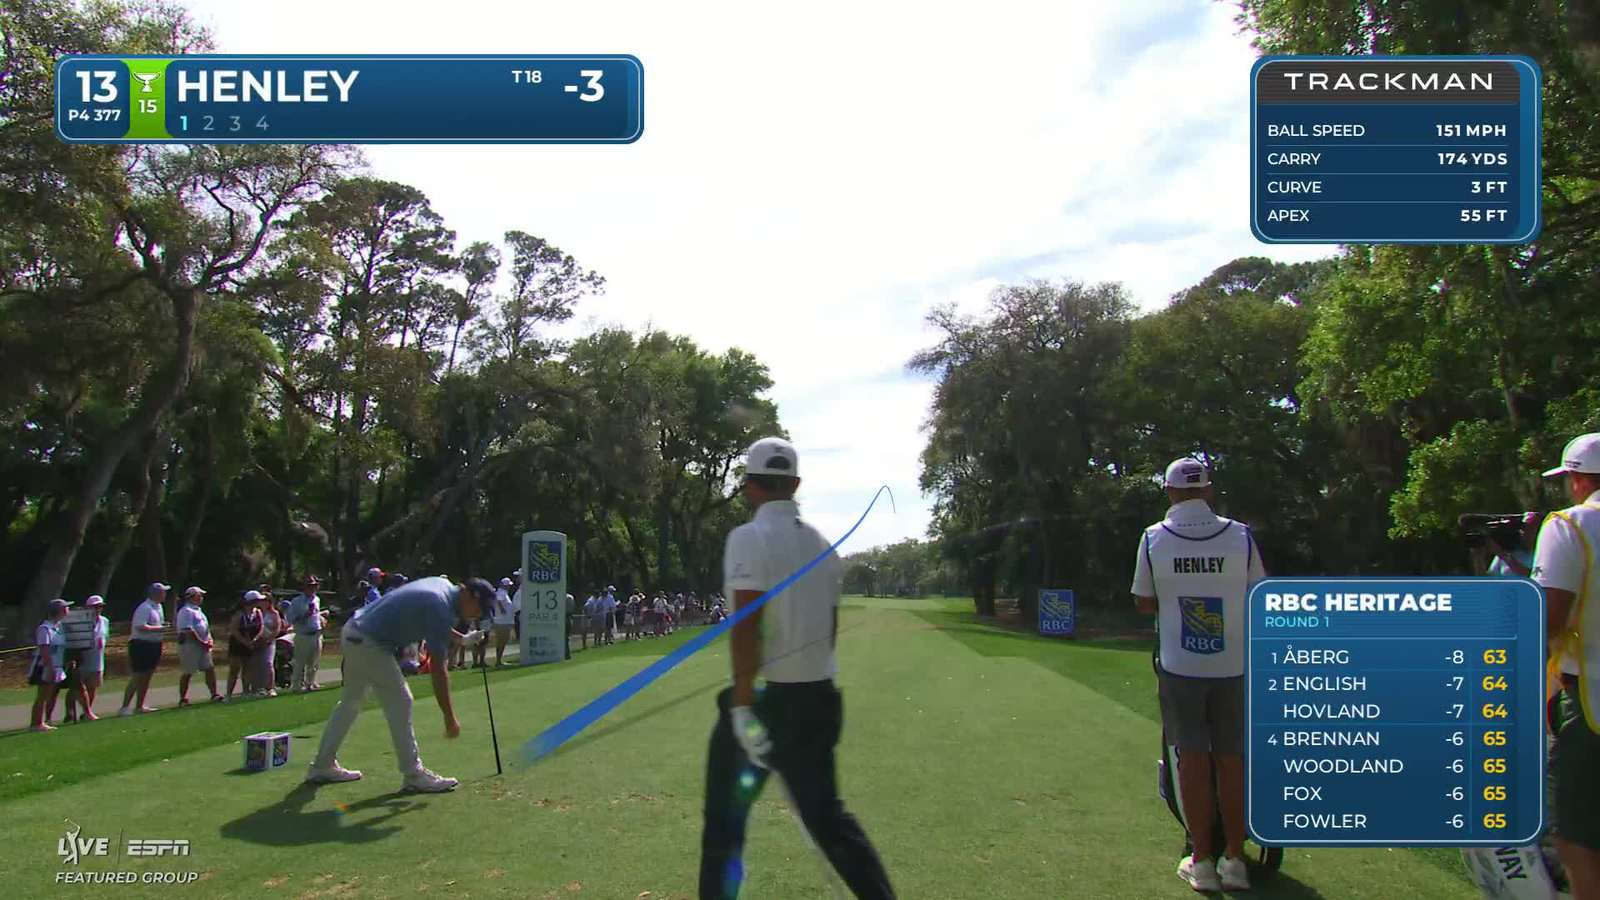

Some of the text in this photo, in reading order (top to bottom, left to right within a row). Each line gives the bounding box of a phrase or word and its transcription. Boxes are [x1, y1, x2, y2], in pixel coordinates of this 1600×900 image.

[1174, 557, 1224, 573] HENLEY
[531, 569, 559, 581] RBC
[529, 590, 558, 610] 13
[1042, 619, 1070, 630] RBC
[1185, 636, 1222, 650] RBC
